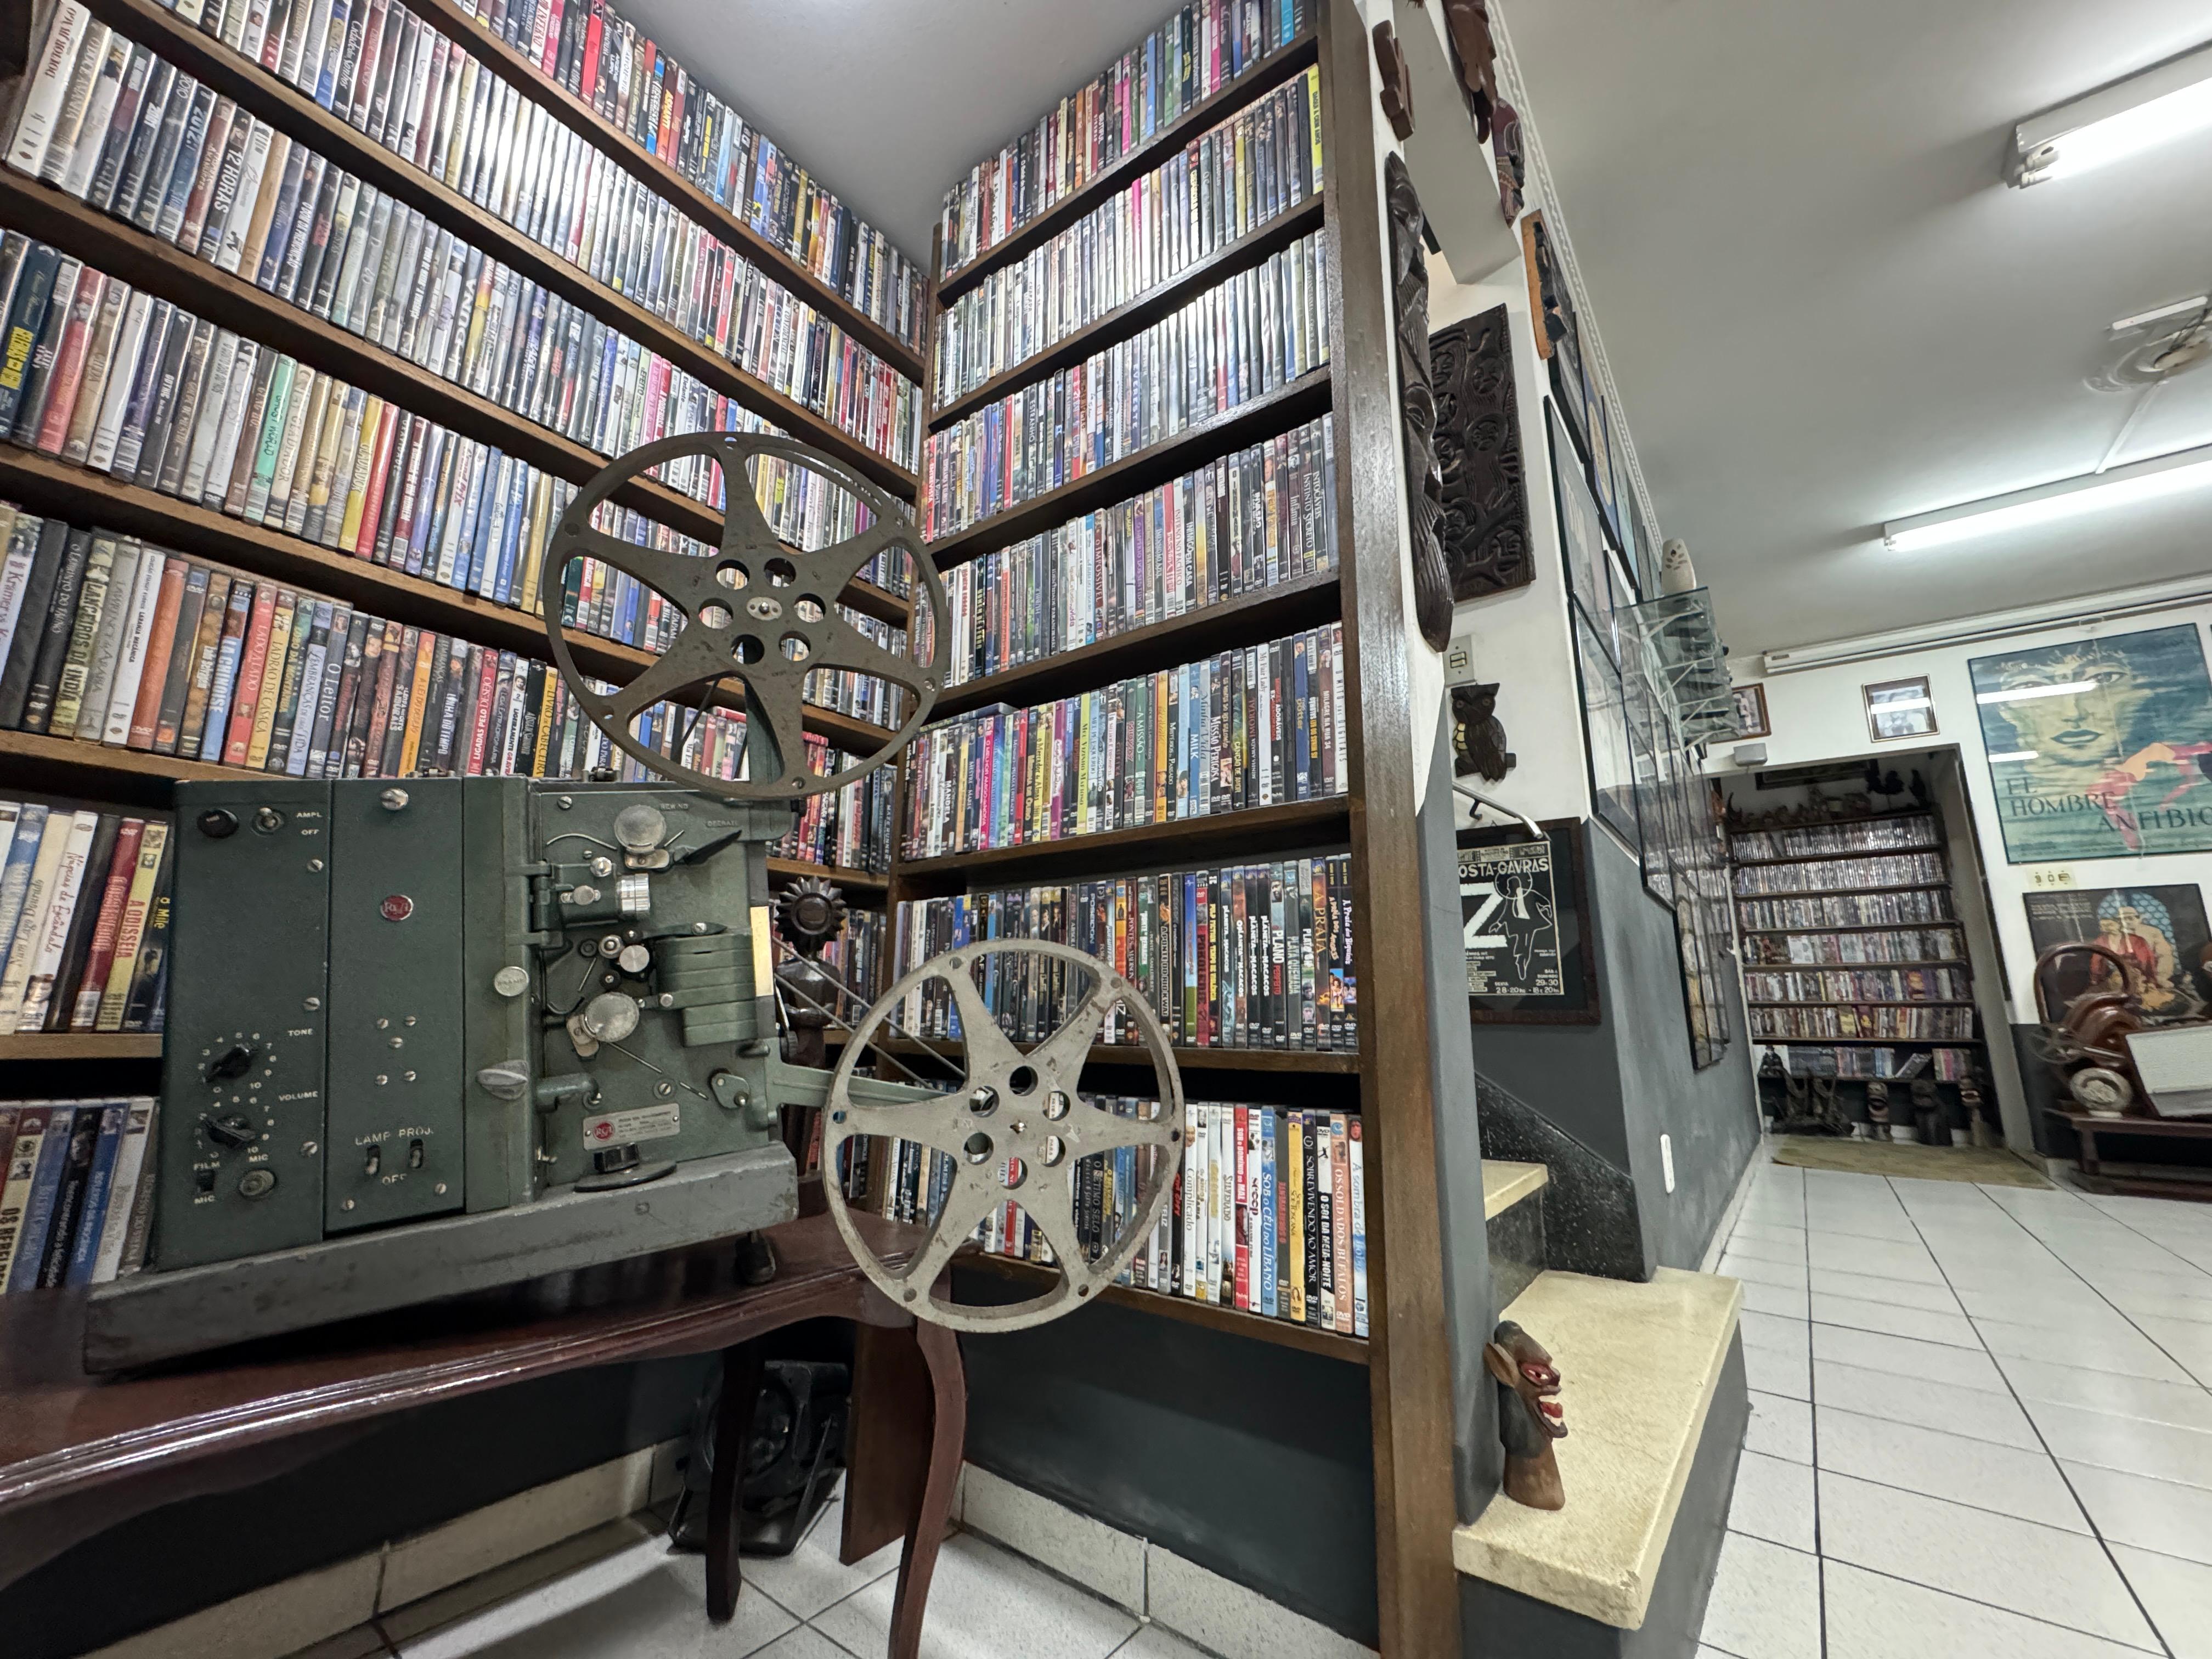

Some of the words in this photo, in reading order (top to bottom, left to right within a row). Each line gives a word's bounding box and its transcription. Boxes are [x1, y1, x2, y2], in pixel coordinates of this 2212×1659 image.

[347, 20, 362, 52] Cidade
[535, 9, 549, 48] INFERNO
[176, 74, 193, 99] 2010
[340, 58, 355, 89] Sonhos
[144, 101, 163, 128] 2001
[663, 89, 674, 129] ASHANTI
[227, 149, 242, 167] 12
[215, 163, 236, 213] HORAS
[482, 259, 495, 285] DUNA
[455, 278, 477, 347] DUNA
[637, 370, 647, 396] EFEITO
[680, 376, 689, 403] Elefante
[657, 397, 667, 428] PODEROSA
[264, 426, 279, 455] WORLD
[279, 415, 302, 482] GLADIADOR
[1304, 473, 1314, 512] INSTINTO
[1312, 471, 1323, 520] INTOCÁVEIS
[1290, 495, 1300, 527] Infâmia
[1186, 521, 1195, 553] INIMIGO
[1305, 514, 1313, 548] SECRETO
[1185, 554, 1193, 564] EM
[1185, 565, 1193, 587] CASA
[77, 583, 104, 648] LANCEIROS
[135, 612, 145, 635] LARANJA
[129, 636, 140, 663] MECÂNICA
[221, 639, 237, 654] LA
[254, 625, 268, 652] LADO
[71, 651, 87, 667] DA
[265, 641, 284, 682] LADRÃO
[327, 663, 341, 674] O
[209, 657, 234, 713] CHINOISE
[247, 662, 262, 691] LADO
[263, 683, 275, 695] DE
[1336, 680, 1345, 699] MITO
[319, 676, 340, 721] Leitor
[444, 693, 458, 718] LINHA
[480, 676, 492, 708] DESEJO
[543, 690, 554, 718] LIVRO
[256, 696, 273, 733] CASACA
[389, 684, 404, 731] SAMURAIS
[477, 709, 488, 727] PELO
[1200, 693, 1210, 729] Minha
[442, 720, 453, 730] DO
[508, 708, 520, 751] LIGEIRAMENTE
[1136, 720, 1146, 754] MISSÃO
[1211, 715, 1222, 743] MISSÃO
[438, 730, 452, 754] TEMPO
[473, 729, 485, 760] LIGADAS
[537, 724, 550, 774] CABECEIRA
[1190, 734, 1199, 760] MILK
[1200, 732, 1210, 760] Vida
[1234, 742, 1242, 765] CANÇÃO
[1325, 741, 1331, 749] 34
[1338, 719, 1347, 762] DIGITAIS
[1168, 759, 1176, 785] PASSADO
[1210, 744, 1222, 782] PERIGOSA
[1235, 766, 1242, 776] DE
[2006, 776, 2037, 795] EL
[943, 781, 952, 823] MANDELA
[2011, 792, 2117, 817] HOMBRE
[1459, 858, 1549, 878] OSTA-GAVRAS
[24, 878, 45, 917] Dourado
[129, 899, 143, 909] A
[1315, 893, 1323, 901] A
[154, 909, 170, 930] Mile
[1344, 906, 1353, 927] Praia
[1459, 882, 1508, 949] Z
[1314, 907, 1327, 953] PRAIA
[1272, 930, 1284, 964] PLANO
[1286, 936, 1298, 956] PLATA
[1161, 963, 1169, 975] DO
[1288, 958, 1301, 994] QUEMADA
[1161, 977, 1169, 991] RIO
[279, 1091, 318, 1102] VOLUME
[355, 1132, 391, 1146] LAMP
[194, 1161, 221, 1171] FILM
[249, 1154, 269, 1163] MIC
[382, 1173, 407, 1186] OFF
[1263, 1172, 1272, 1196] SOB
[194, 1195, 216, 1204] MIC
[1185, 1167, 1195, 1232] Complicado
[1306, 1155, 1316, 1232] SOBREVIVENDO
[1352, 1175, 1361, 1217] sombra
[1092, 1208, 1101, 1233] SELO
[1263, 1207, 1273, 1227] CÉU
[1321, 1205, 1330, 1222] SOL
[1335, 1183, 1346, 1242] SOLDADOS
[1308, 1233, 1316, 1249] AO
[1321, 1224, 1330, 1234] DA
[1263, 1240, 1273, 1290] LÍBANO
[1308, 1251, 1317, 1283] AMOR
[1321, 1235, 1331, 1288] MEIA-NOITE
